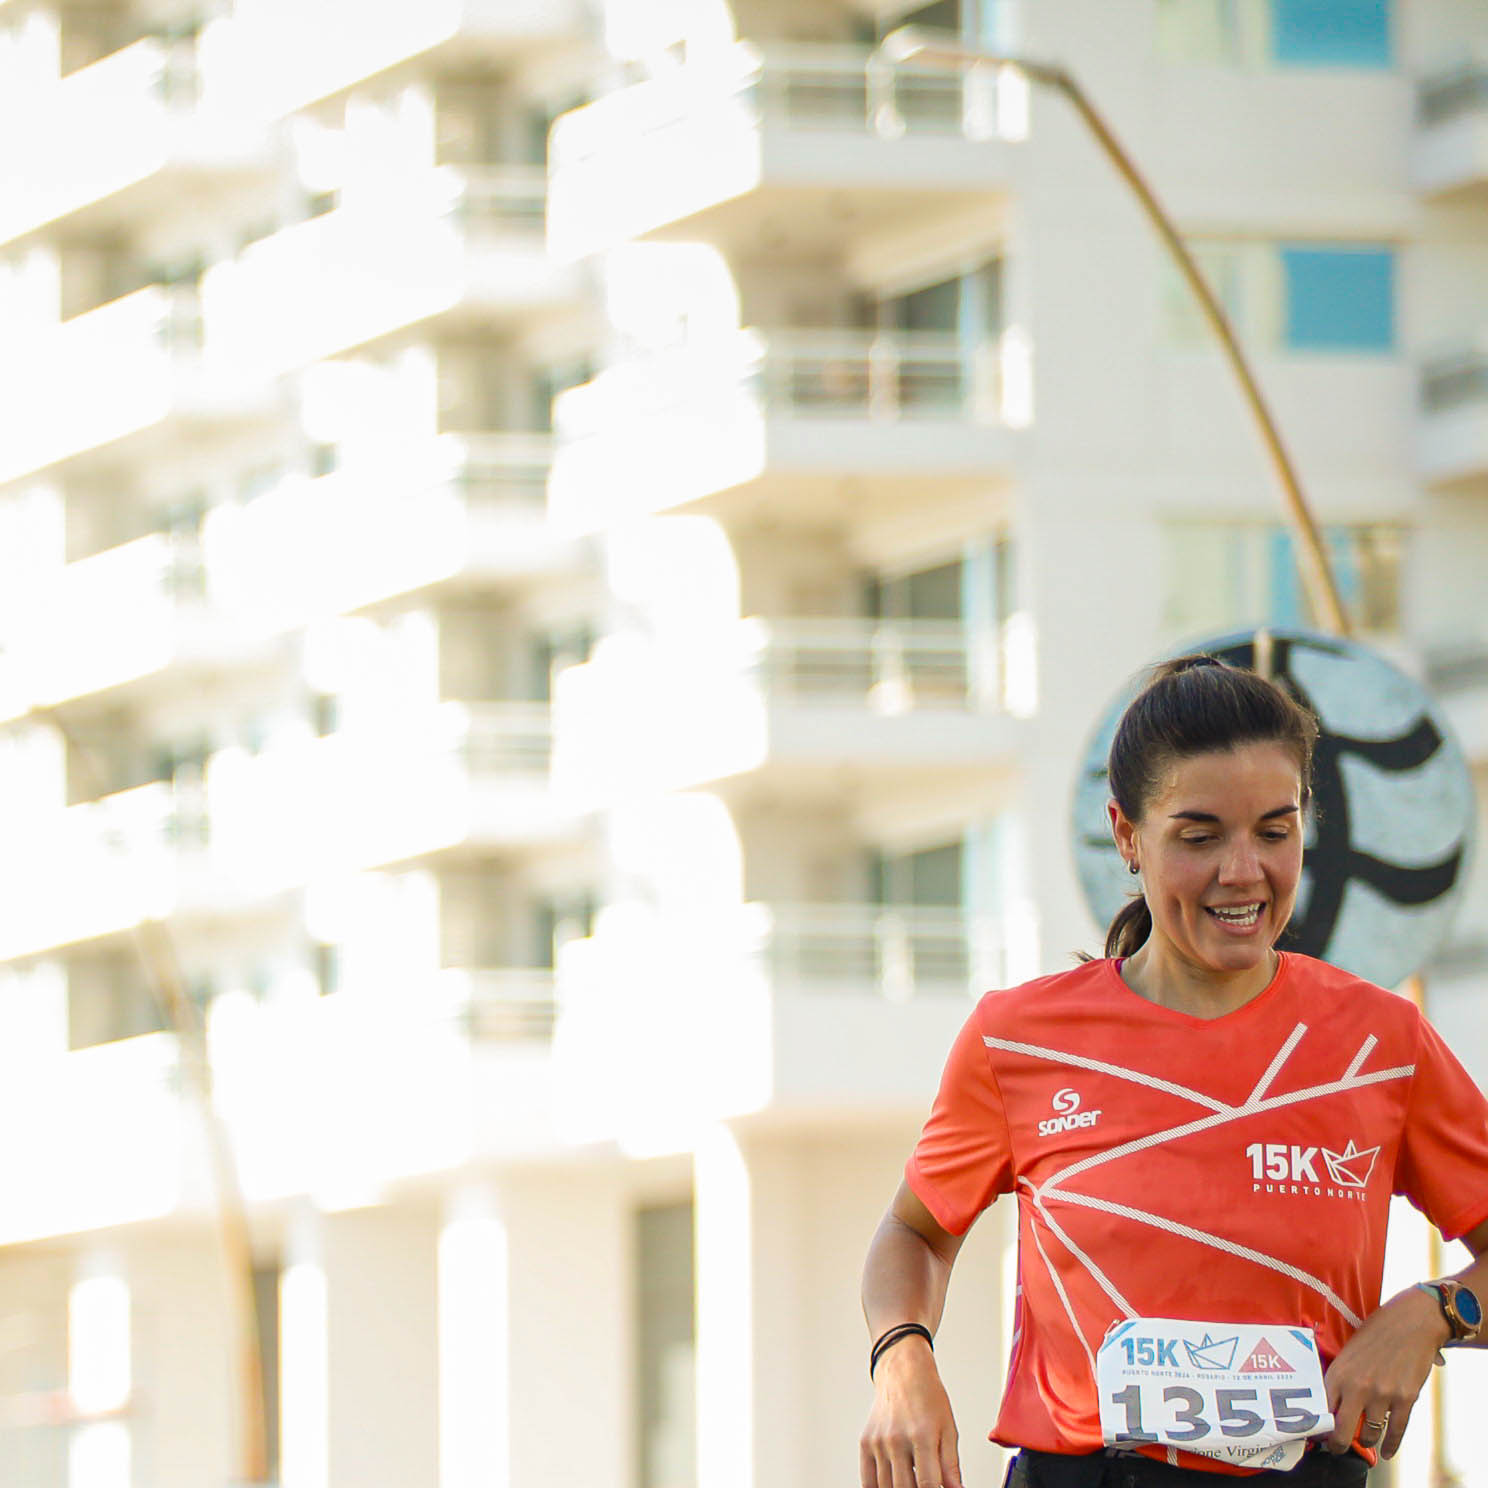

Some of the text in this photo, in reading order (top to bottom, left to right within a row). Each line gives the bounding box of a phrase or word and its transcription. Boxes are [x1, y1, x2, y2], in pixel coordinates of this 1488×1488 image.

[1246, 1143, 1320, 1183] 15K
[1253, 1183, 1366, 1202] PUERTO NORTE
[1120, 1337, 1180, 1368] 15K
[1250, 1354, 1282, 1370] 15K
[1111, 1384, 1321, 1442] 1355
